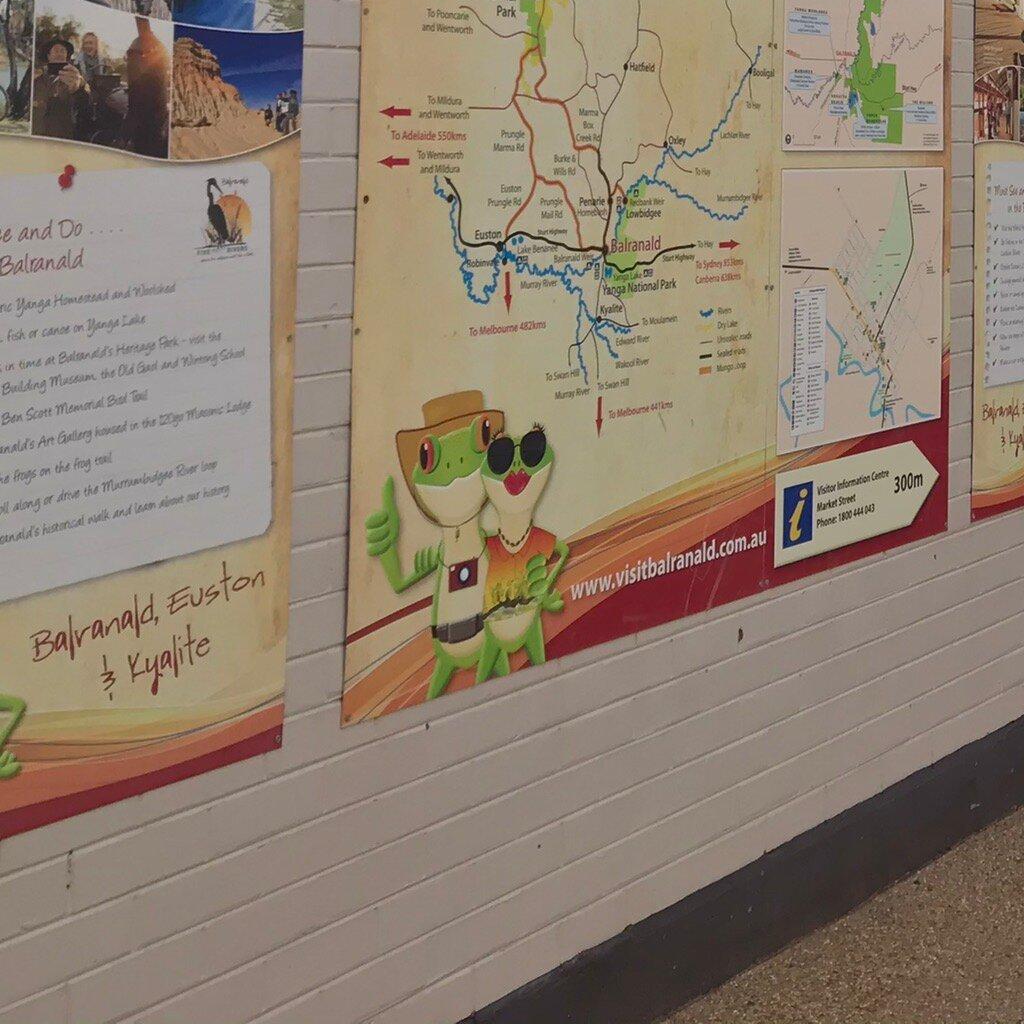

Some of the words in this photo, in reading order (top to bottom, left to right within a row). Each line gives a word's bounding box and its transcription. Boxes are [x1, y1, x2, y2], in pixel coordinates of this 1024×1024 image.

[496, 5, 516, 18] Park
[436, 24, 474, 35] Wentworth
[629, 61, 655, 72] Hatfield
[437, 95, 462, 106] Mildura
[433, 110, 470, 120] Wentworth
[401, 130, 436, 141] Adelaide
[668, 136, 686, 147] Oxley
[426, 150, 464, 160] Wentworth
[434, 164, 461, 174] Mildura
[626, 209, 661, 220] Lowbidgee
[18, 219, 53, 242] and
[58, 219, 83, 239] Do
[474, 229, 502, 240] Euston
[517, 245, 531, 255] Lake
[610, 235, 661, 253] Balranald
[0, 247, 84, 276] Balranald
[703, 259, 723, 271] Sydney
[520, 279, 541, 290] Murray
[541, 278, 558, 288] River
[602, 283, 627, 297] Yanga
[627, 280, 659, 293] National
[660, 278, 677, 290] Park
[16, 297, 51, 317] Yanga
[53, 289, 109, 307] Homestead
[111, 287, 130, 300] and
[600, 304, 623, 316] Kyalite
[7, 329, 26, 342] fish
[42, 325, 71, 336] canoe
[87, 318, 119, 337] Yanga
[121, 315, 146, 327] Lake
[478, 324, 519, 336] Melbourne
[19, 358, 42, 369] time
[45, 357, 55, 366] at
[58, 345, 113, 364] Balranald's
[1, 379, 47, 396] Building
[100, 368, 114, 379] the
[118, 363, 134, 377] Old
[161, 357, 179, 370] and
[553, 370, 568, 380] Swan
[554, 389, 575, 401] Murray
[575, 387, 591, 397] River
[1, 411, 23, 426] Ben
[26, 406, 52, 421] Scott
[55, 397, 104, 415] Memorial
[617, 404, 650, 417] Melbourne
[38, 435, 54, 449] Art
[57, 430, 92, 444] Gallery
[95, 421, 128, 437] housed
[142, 418, 156, 428] the
[13, 469, 37, 485] frogs
[40, 467, 50, 476] on
[55, 461, 70, 474] the
[74, 457, 91, 473] frog
[13, 497, 41, 513] along
[43, 494, 54, 504] or
[57, 488, 80, 502] drive
[83, 484, 99, 495] the
[101, 470, 174, 493] Murrumbidgee
[176, 463, 199, 477] River
[817, 482, 836, 495] Visitor
[837, 475, 870, 491] Information
[872, 470, 890, 481] Centre
[894, 472, 923, 493] 300m
[817, 499, 838, 512] Market
[839, 494, 856, 507] Street
[42, 515, 86, 534] historical
[88, 509, 110, 524] walk
[112, 503, 132, 519] and
[134, 502, 157, 515] learn
[838, 508, 852, 523] 1800
[853, 507, 864, 517] 444
[570, 530, 768, 600] www.visitbalranald.com.au
[29, 593, 160, 663] Balranald,
[166, 560, 265, 617] Euston
[127, 624, 211, 696] Kyalite
